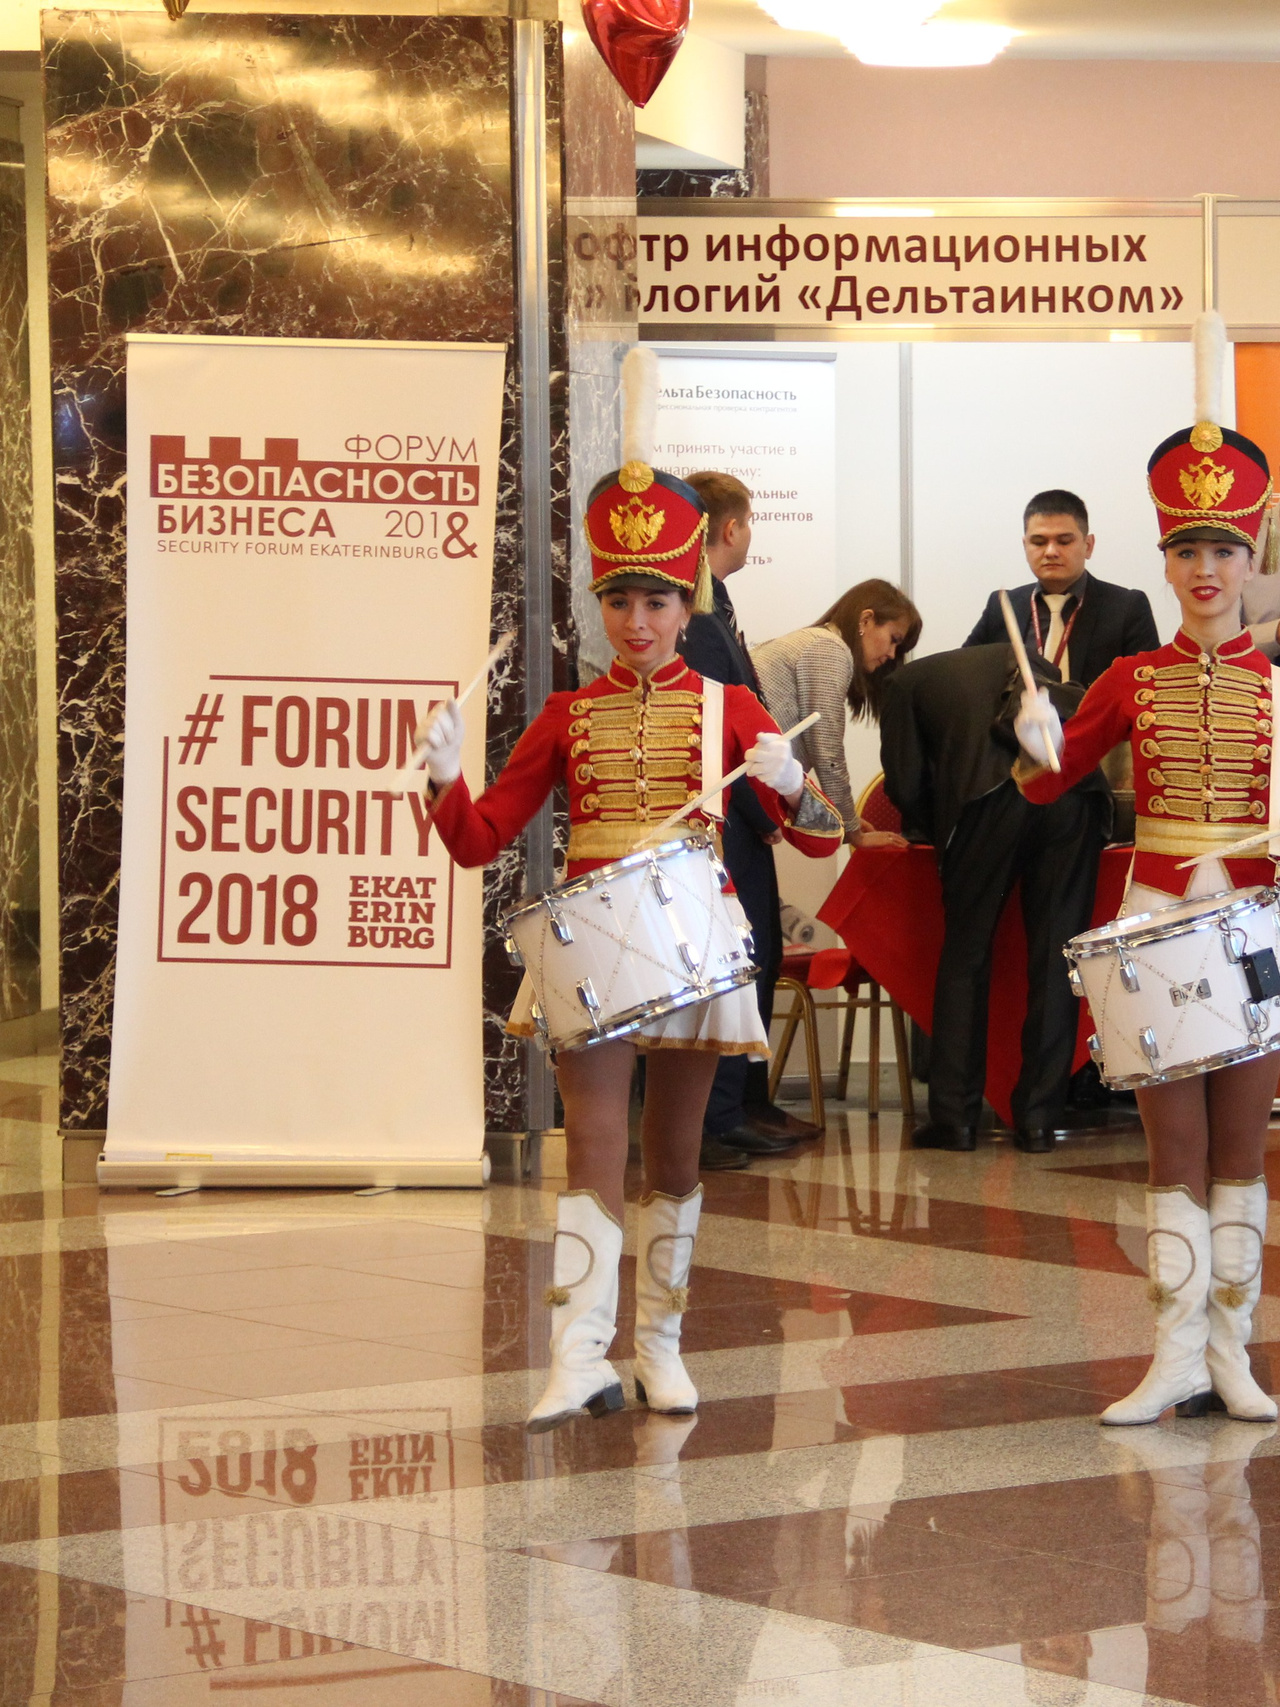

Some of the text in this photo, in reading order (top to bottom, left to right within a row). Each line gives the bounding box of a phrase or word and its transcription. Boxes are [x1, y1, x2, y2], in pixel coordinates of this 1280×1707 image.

[705, 224, 1148, 271] информационных
[637, 273, 780, 312] логий
[798, 276, 1184, 321] «Дельтаинком»
[714, 405, 748, 413] проверка
[344, 433, 478, 463] ФОРУМ
[667, 443, 725, 457] принять
[730, 444, 785, 459] участие
[789, 446, 797, 456] в
[157, 462, 477, 502] БЕЗОПАСНОСТЬ
[724, 465, 762, 481] тему:
[749, 489, 798, 500] альные
[157, 504, 336, 539] БИЗНЕСА
[752, 511, 813, 525] рагентов
[157, 539, 439, 560] SECURITY FORUM EKATERINBURG
[175, 785, 437, 857] SECURITY
[349, 875, 437, 899] EKAT
[177, 871, 319, 947] 2018
[348, 901, 436, 924] ERIN
[347, 925, 435, 950] BURG
